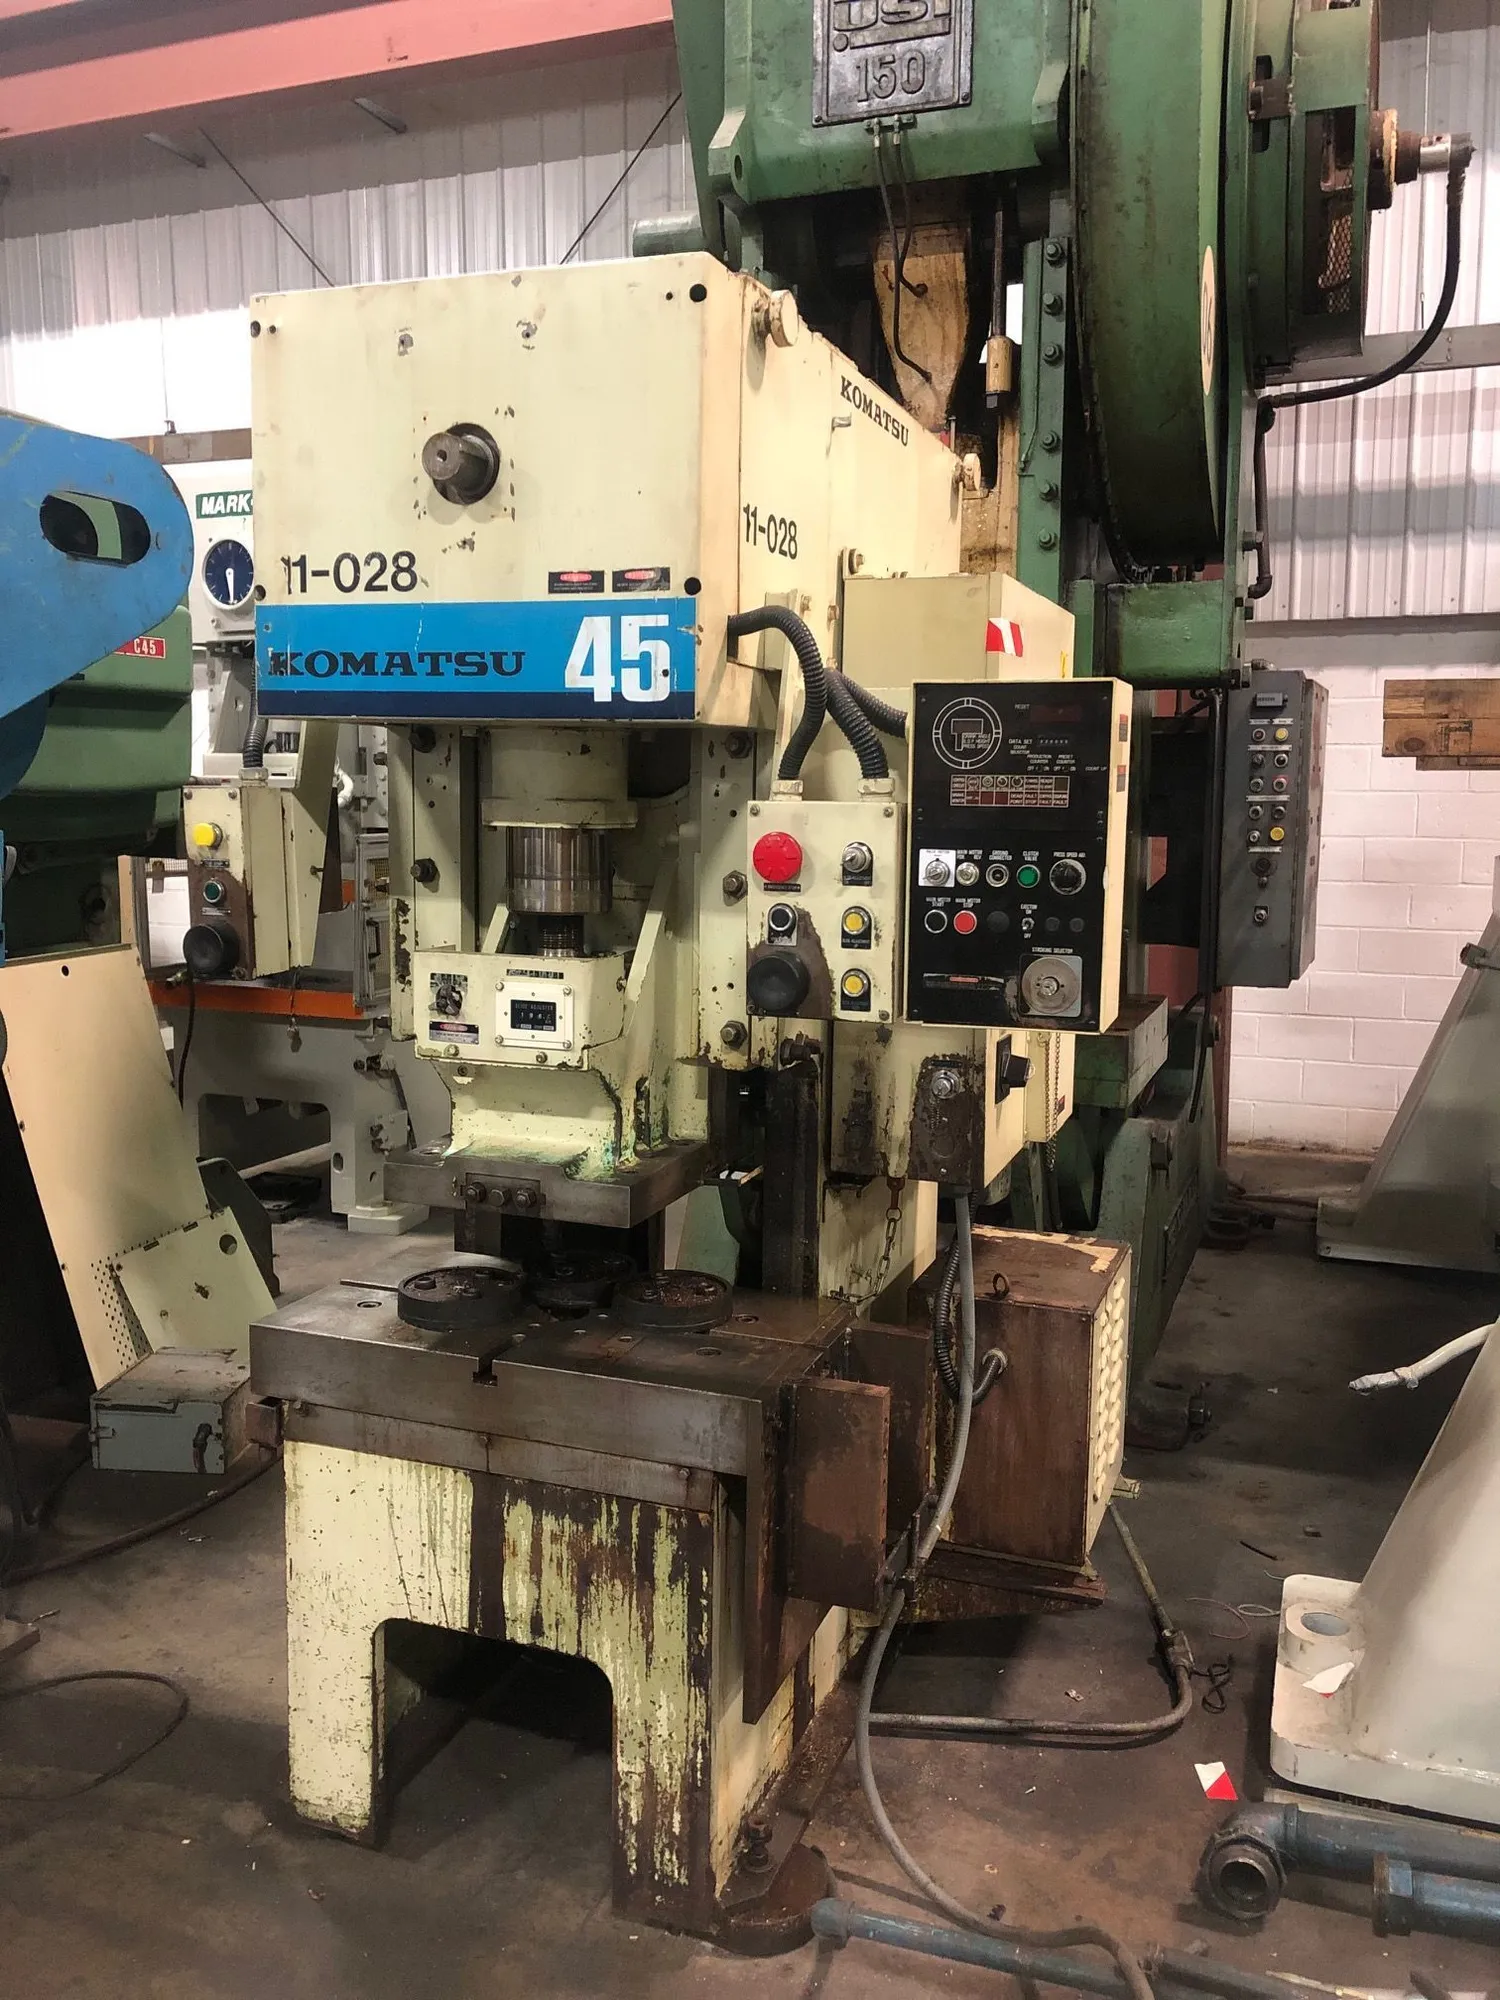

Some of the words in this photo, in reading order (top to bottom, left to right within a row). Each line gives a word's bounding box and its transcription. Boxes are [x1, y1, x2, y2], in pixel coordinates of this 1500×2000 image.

[856, 49, 926, 103] 150
[840, 375, 909, 447] KOMATSU
[201, 493, 253, 515] MARK
[743, 503, 798, 560] 11-028
[281, 551, 418, 594] 11-028
[268, 650, 526, 677] KOMATSU
[565, 614, 670, 703] 45
